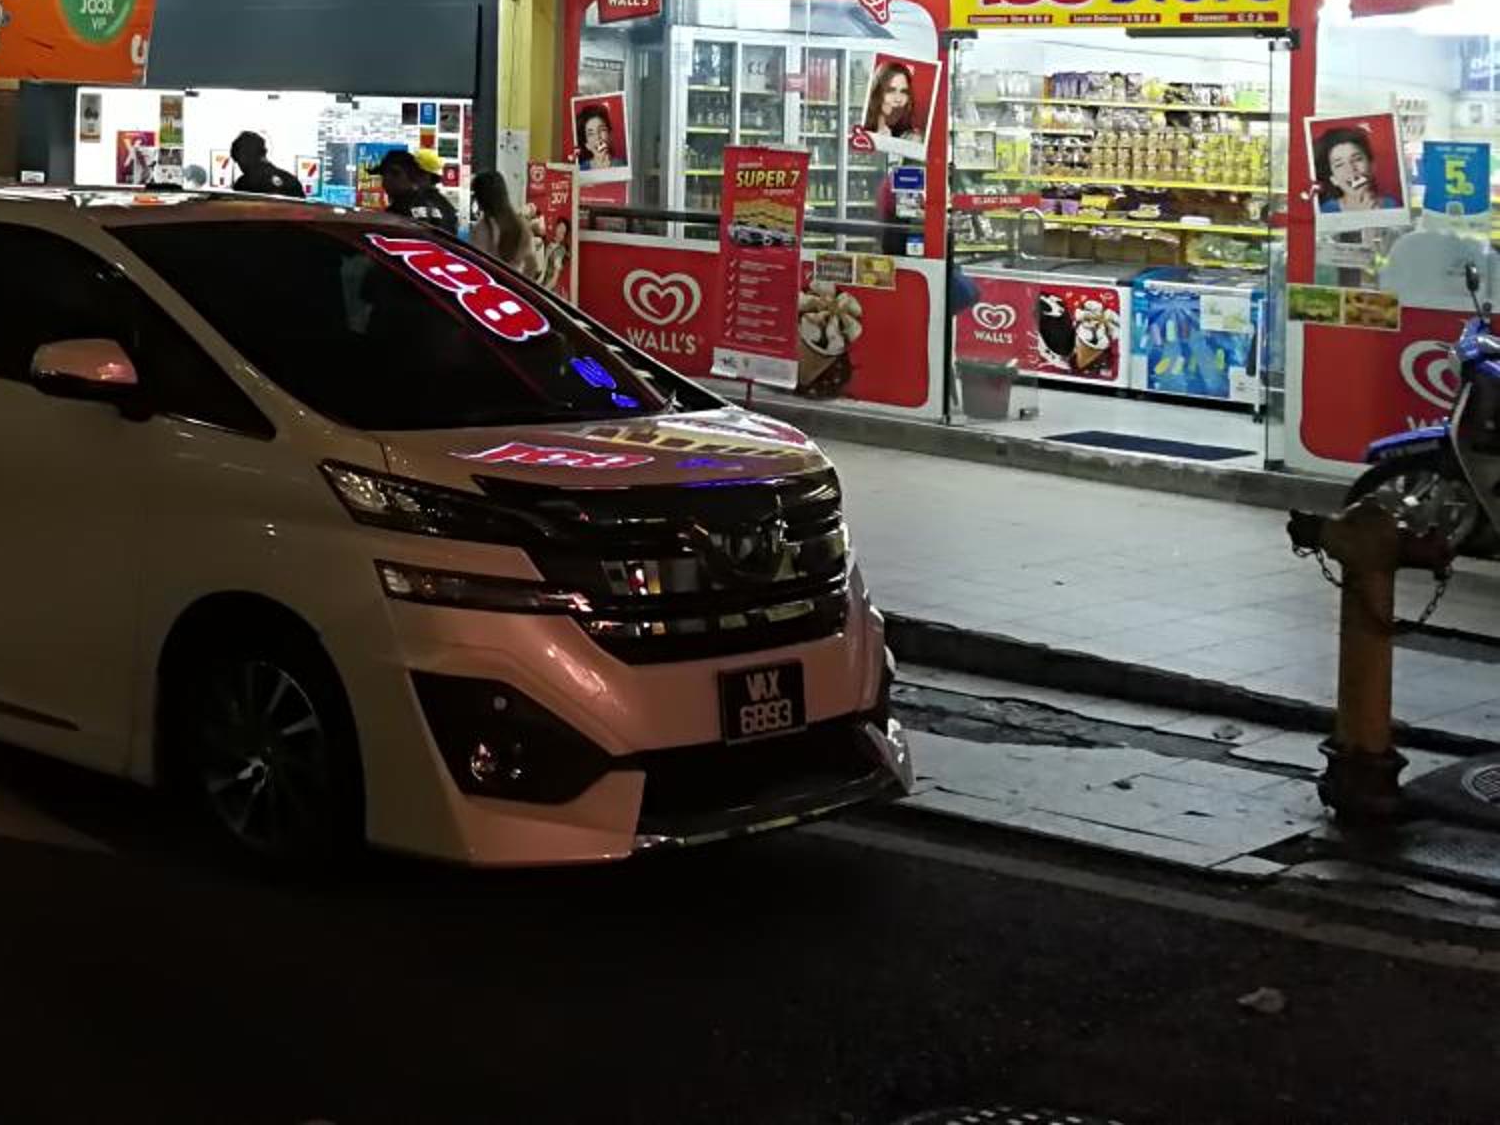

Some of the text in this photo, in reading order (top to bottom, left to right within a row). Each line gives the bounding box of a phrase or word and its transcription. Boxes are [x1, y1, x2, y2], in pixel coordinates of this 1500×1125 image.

[736, 170, 800, 188] SUPER 7
[627, 327, 698, 355] WALL'S
[973, 330, 1013, 344] WALL'S
